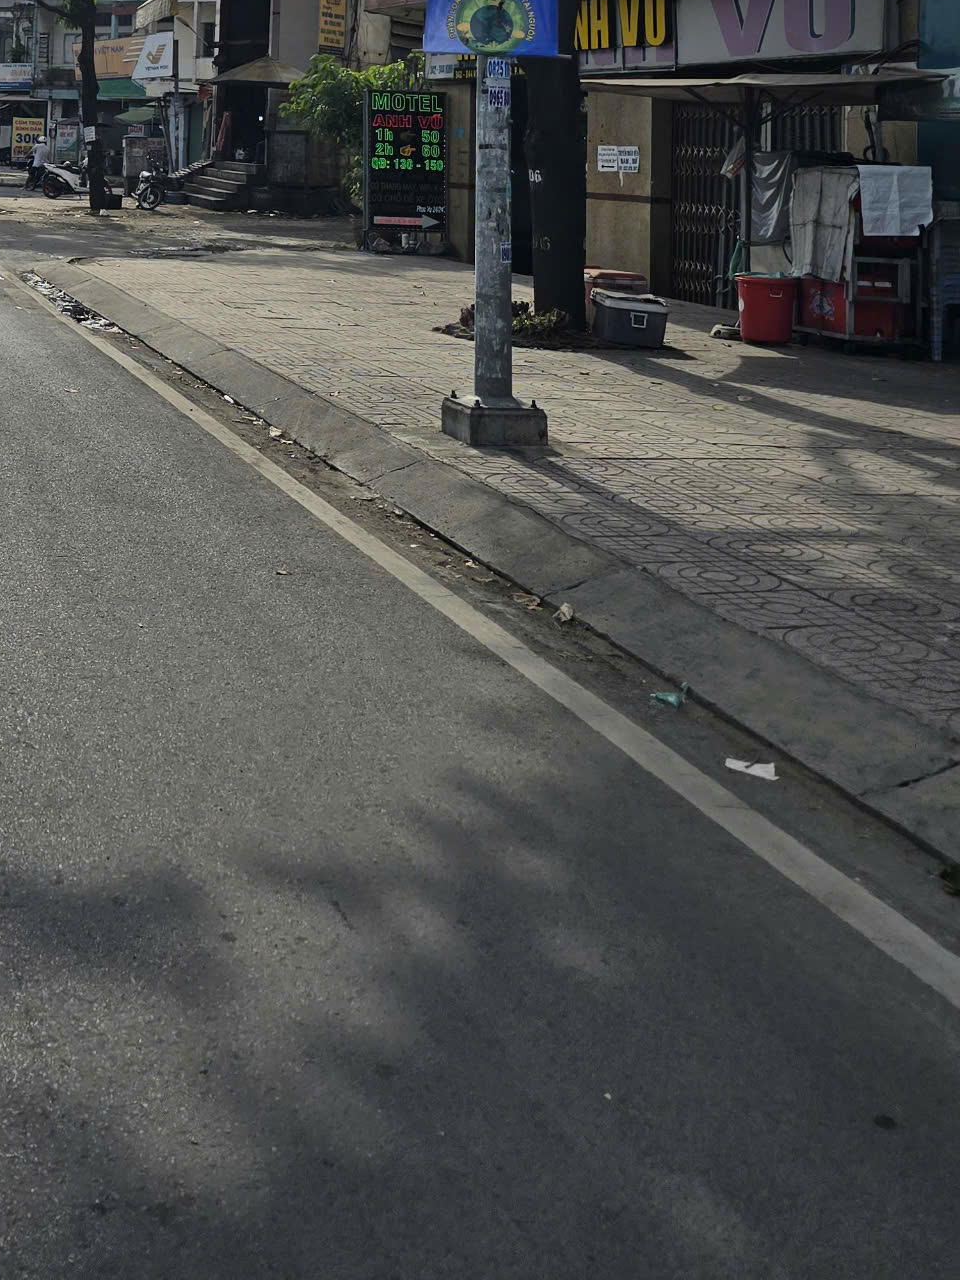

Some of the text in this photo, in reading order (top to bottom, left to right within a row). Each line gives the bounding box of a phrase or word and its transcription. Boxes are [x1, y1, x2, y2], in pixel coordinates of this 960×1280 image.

[371, 93, 443, 113] MOTEL
[372, 113, 444, 129] ANH VŨ
[375, 128, 440, 143] 1h 50
[374, 142, 440, 158] 2h 60
[393, 158, 414, 170] 130
[424, 159, 444, 171] 150
